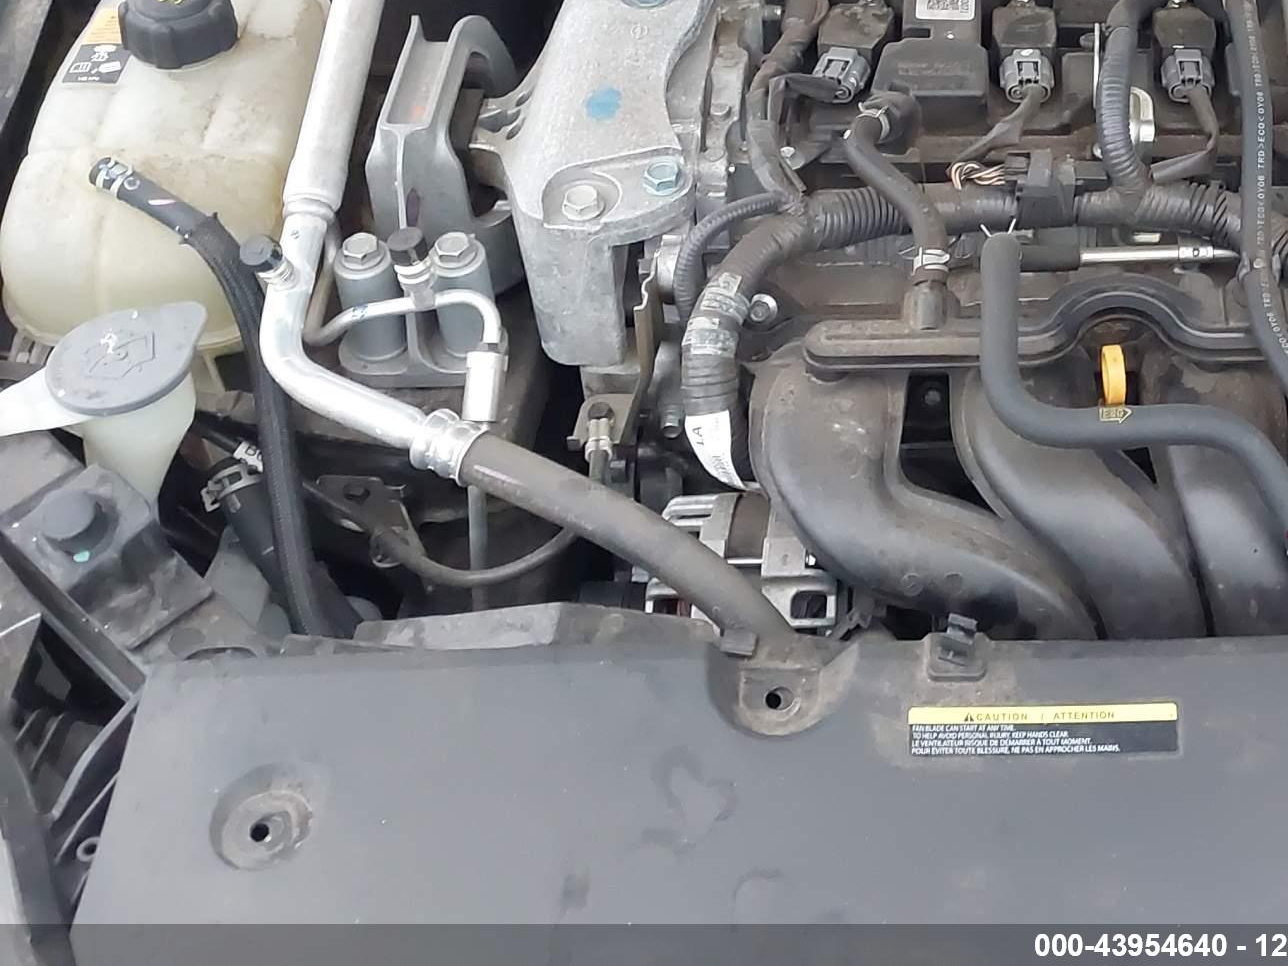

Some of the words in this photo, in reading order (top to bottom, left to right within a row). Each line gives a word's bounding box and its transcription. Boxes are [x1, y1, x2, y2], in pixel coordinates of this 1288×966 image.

[976, 713, 1028, 722] CAUTION
[1053, 711, 1115, 720] ATTENTION
[945, 724, 959, 732] CAN
[965, 739, 988, 747] RISQUE
[1045, 745, 1084, 753] APPROCHER
